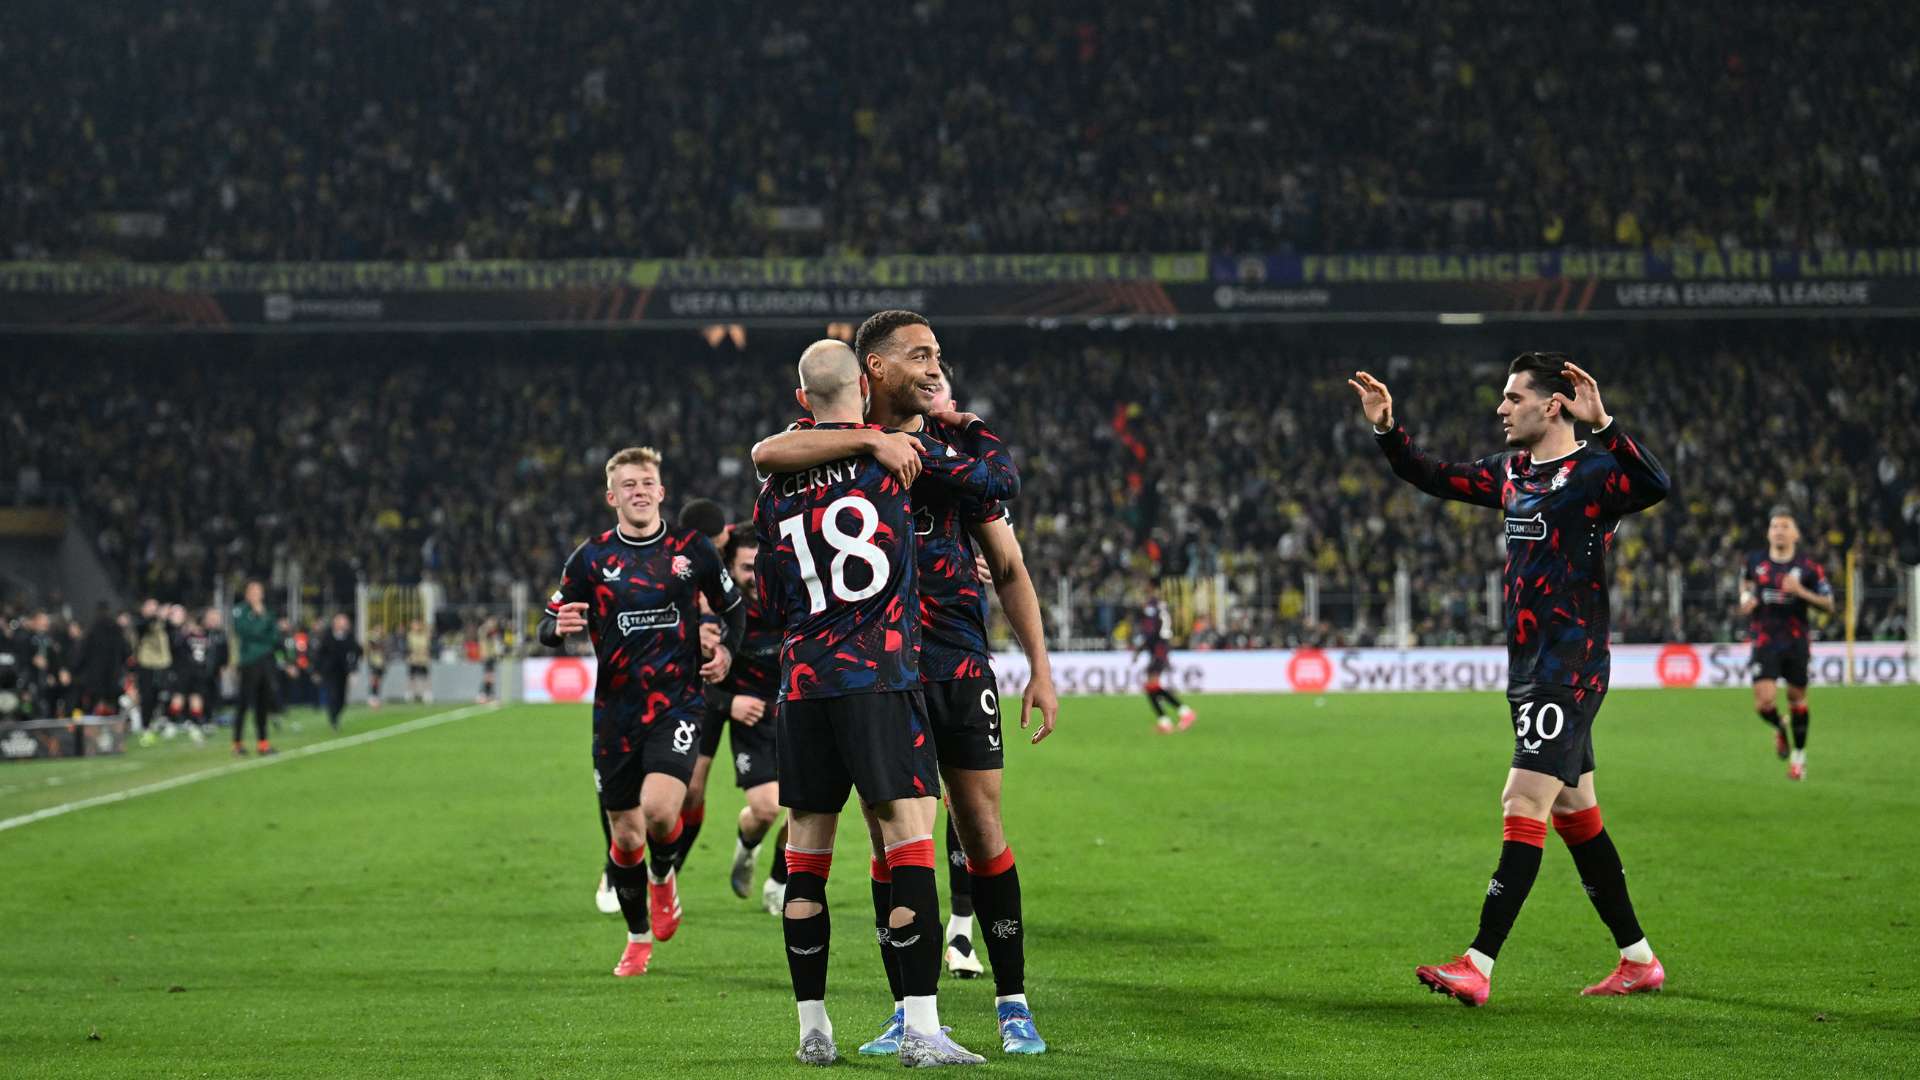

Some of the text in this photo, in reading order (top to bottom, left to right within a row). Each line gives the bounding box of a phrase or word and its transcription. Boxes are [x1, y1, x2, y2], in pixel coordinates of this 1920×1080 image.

[670, 290, 731, 314] UEFA
[1617, 282, 1868, 306] UEFA EUROPA LEAGUE
[778, 495, 890, 615] 18
[980, 688, 999, 730] 9
[1516, 701, 1564, 740] 30
